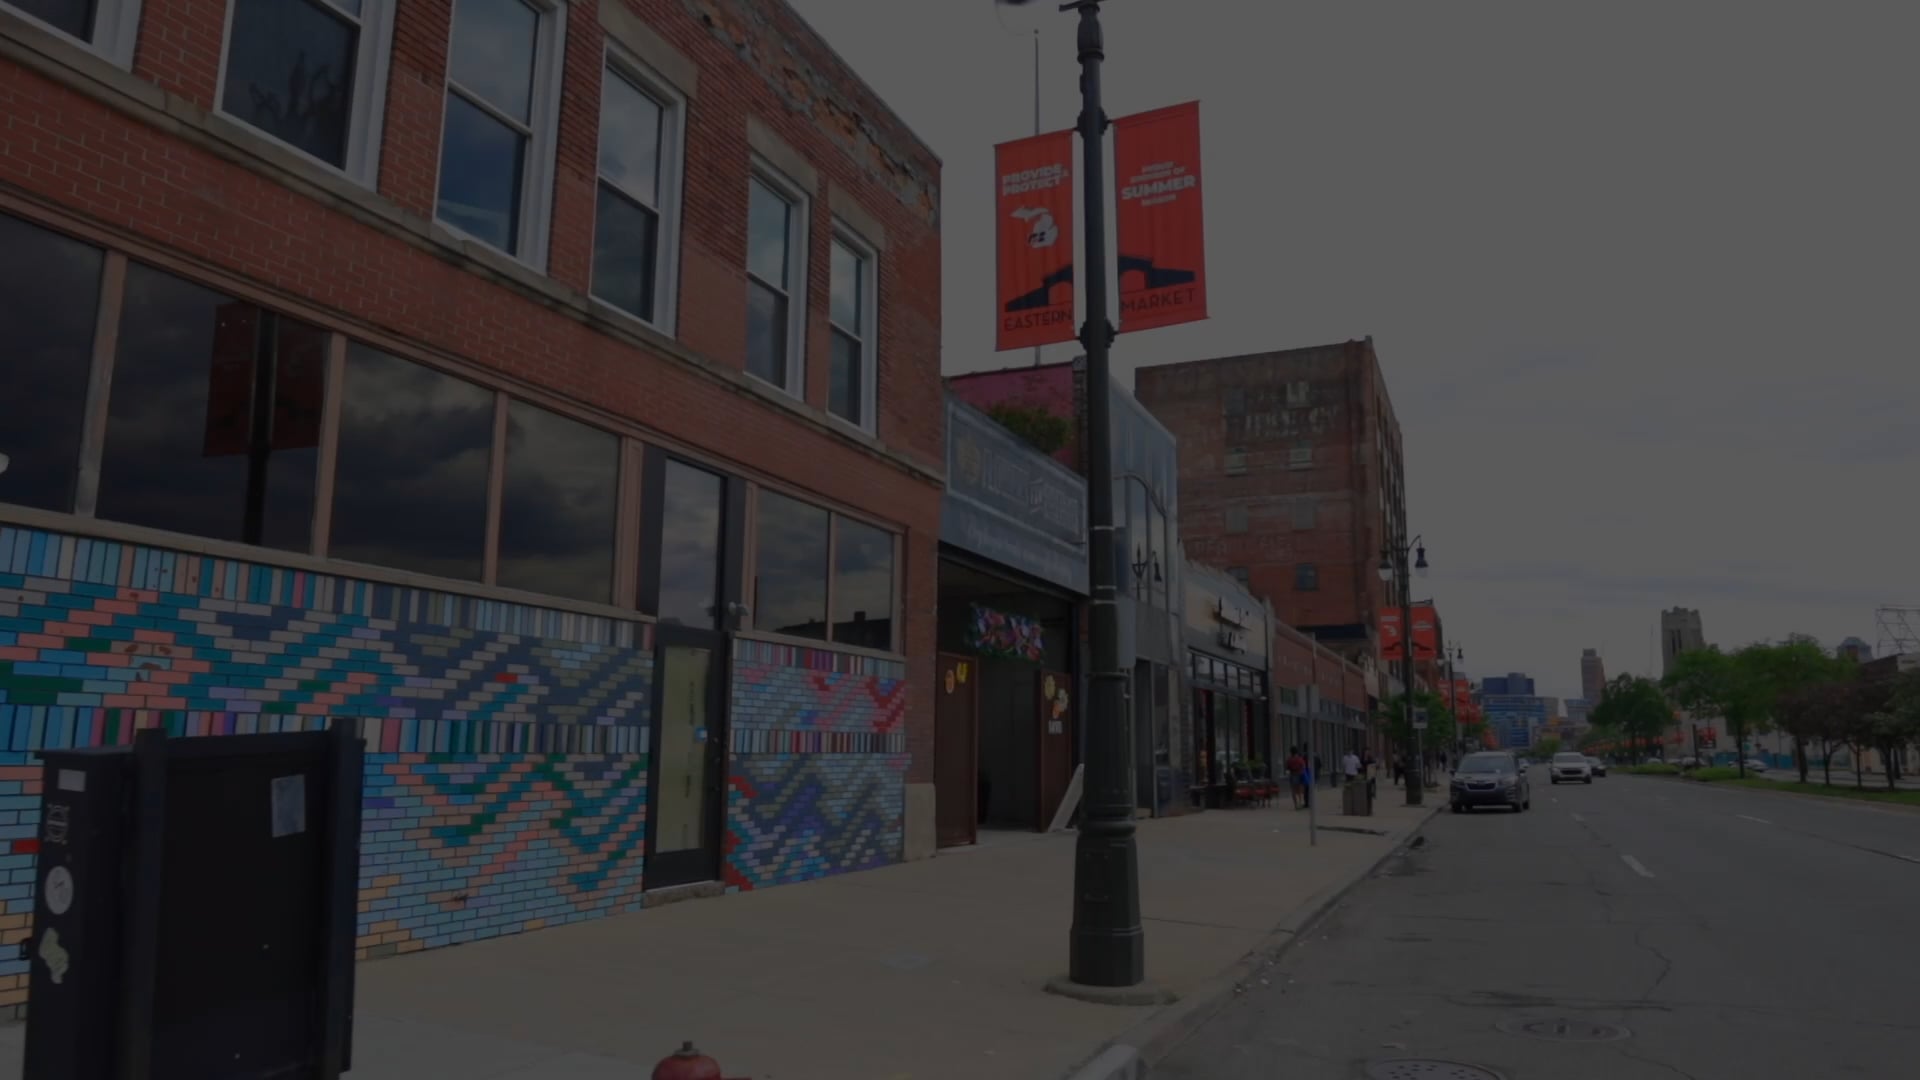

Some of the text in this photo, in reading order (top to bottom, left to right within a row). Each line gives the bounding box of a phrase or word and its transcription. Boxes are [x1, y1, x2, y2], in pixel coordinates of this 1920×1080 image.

[1002, 163, 1063, 184] PROVIDE
[1002, 176, 1061, 196] PROTECT
[1121, 175, 1196, 200] SUMMER
[1120, 288, 1196, 312] MARKET
[1004, 309, 1073, 331] EASTERN
